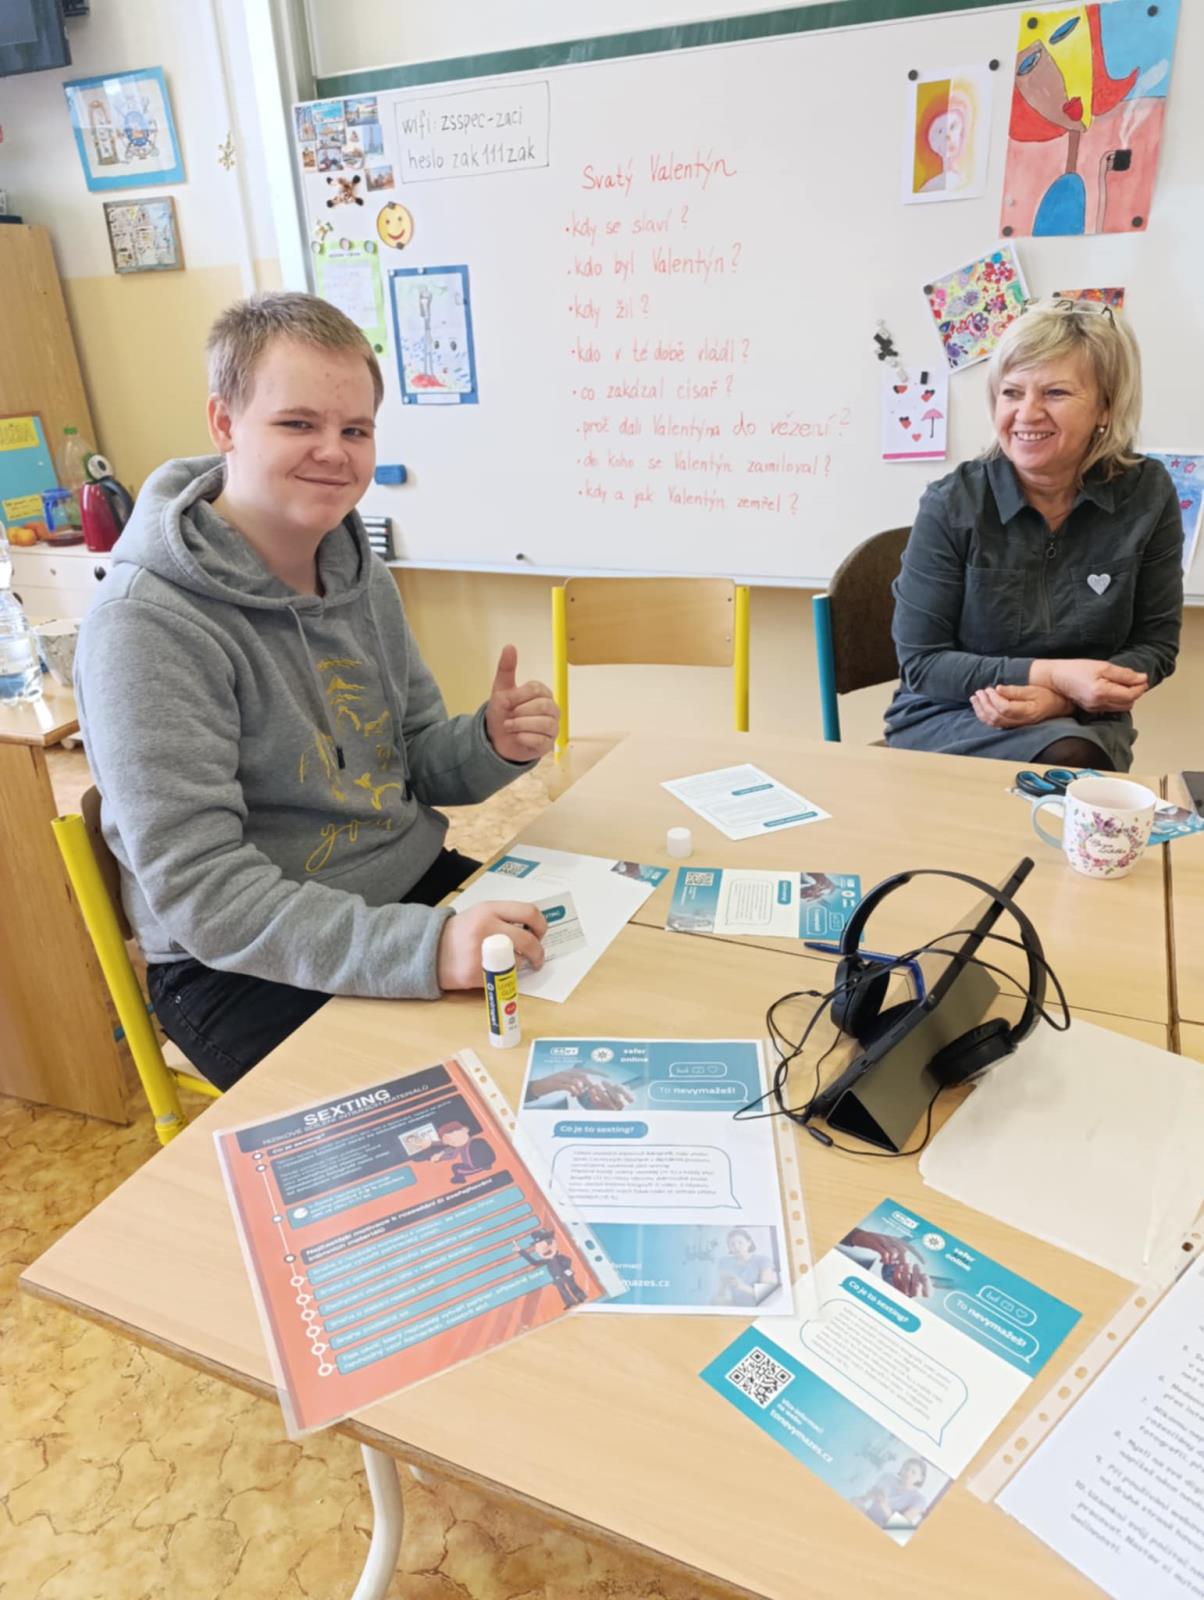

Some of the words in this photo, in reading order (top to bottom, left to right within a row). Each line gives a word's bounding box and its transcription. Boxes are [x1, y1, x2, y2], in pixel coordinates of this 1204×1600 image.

[408, 149, 444, 169] heslo
[582, 157, 634, 197] Svatý
[650, 148, 738, 190] Valentýn
[572, 210, 598, 246] kdy
[606, 221, 621, 235] se
[632, 208, 672, 234] slaví
[575, 254, 603, 277] kdo
[613, 251, 635, 282] byl
[574, 295, 601, 328] kdy
[577, 337, 601, 362] kdo
[580, 386, 596, 400] co
[606, 375, 664, 400] zakázal
[582, 416, 610, 440] proč
[619, 415, 642, 436] dali
[653, 412, 721, 441] Valentýna
[733, 411, 757, 438] do
[583, 450, 598, 467] do
[607, 452, 635, 469] koho
[648, 457, 663, 470] se
[674, 450, 733, 475] Valentýn
[585, 479, 607, 501] kdy
[614, 490, 625, 501] a
[634, 483, 654, 508] jak
[668, 484, 726, 512] Valentýn
[737, 492, 781, 513] zemřel
[620, 1056, 649, 1064] online
[660, 1086, 671, 1096] To
[303, 1088, 391, 1127] SEXTING
[560, 1124, 573, 1133] Co
[574, 1124, 583, 1135] je
[584, 1124, 593, 1133] to
[595, 1123, 635, 1136] sexting?
[849, 1280, 859, 1289] Co
[857, 1286, 867, 1295] je
[867, 1292, 877, 1301] to
[875, 1299, 908, 1324] sexting?
[956, 1300, 968, 1310] To
